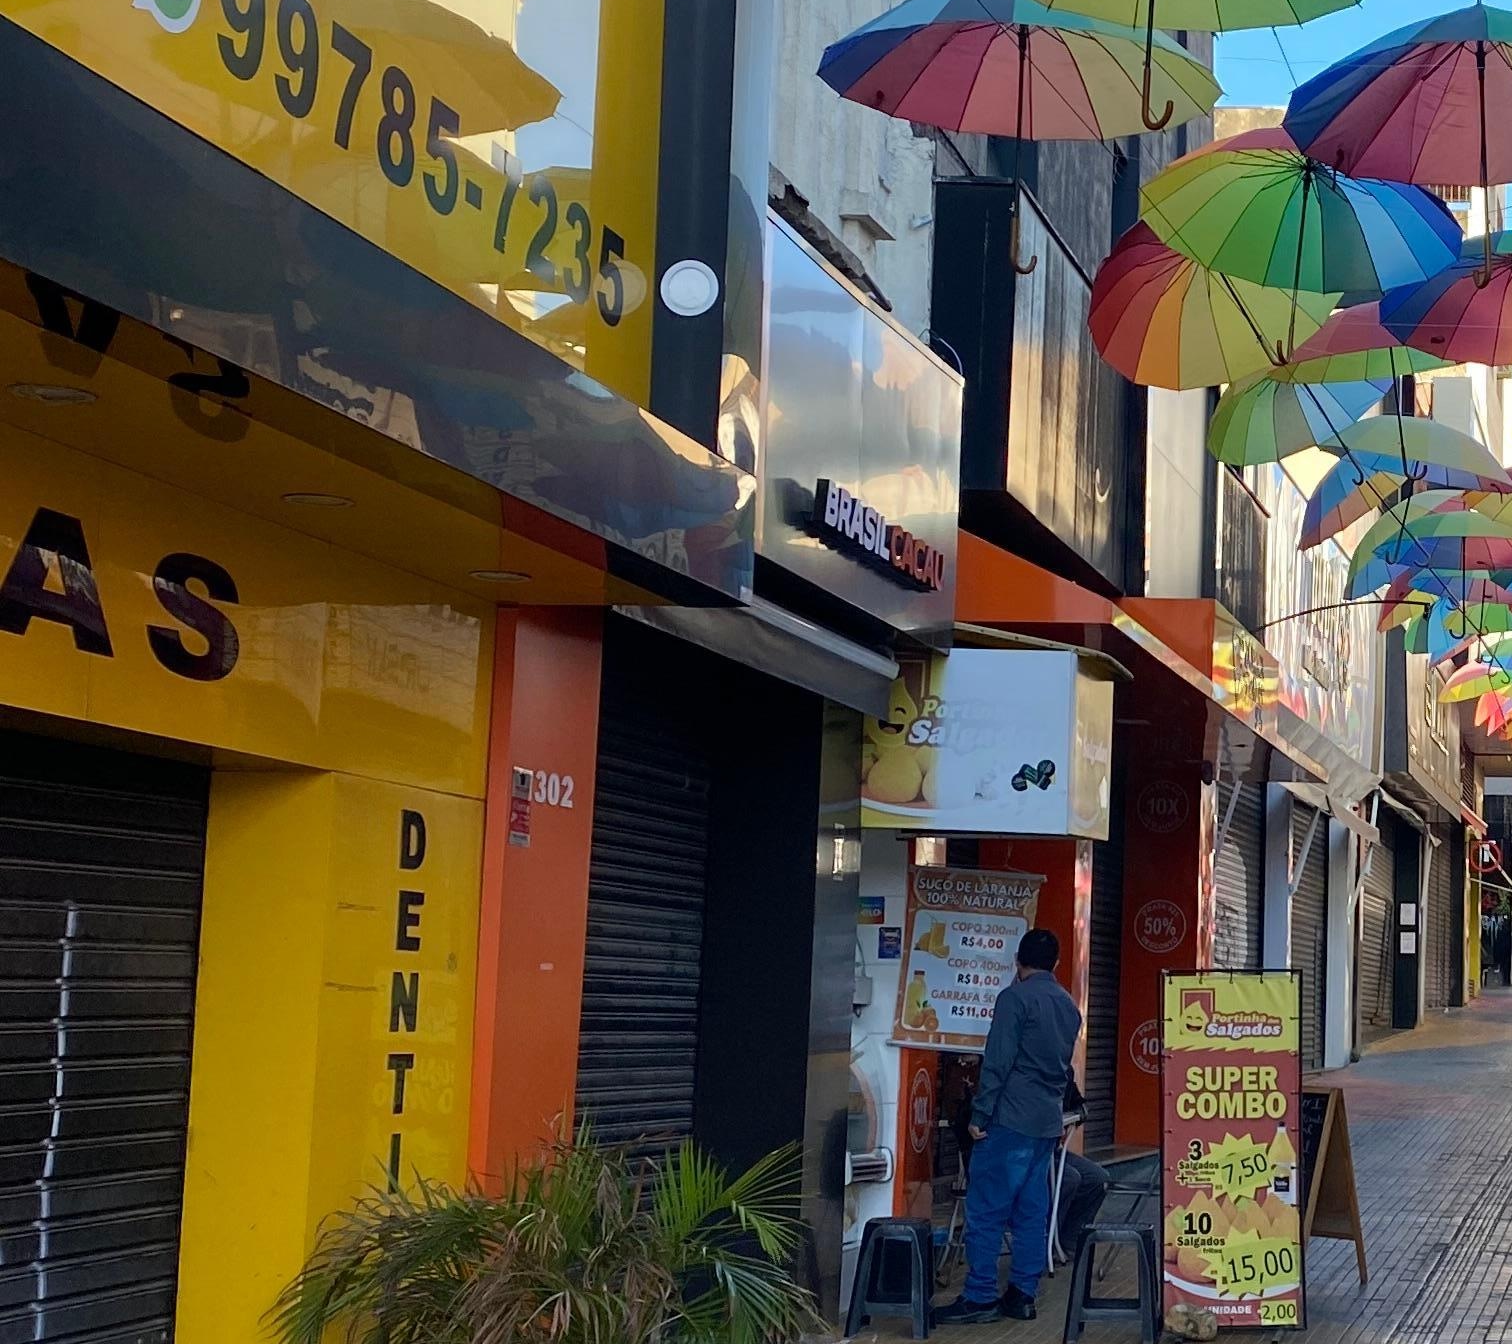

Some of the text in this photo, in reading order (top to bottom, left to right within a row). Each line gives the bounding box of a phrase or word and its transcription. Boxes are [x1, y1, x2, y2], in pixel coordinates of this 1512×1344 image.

[534, 769, 574, 808] 302
[918, 878, 1032, 898] SUCO DE LARANJA
[927, 892, 1021, 911] 100% NATURAL
[951, 921, 982, 934] COPO
[1143, 917, 1176, 936] 50%
[947, 957, 978, 970] COPO
[931, 989, 980, 1002] GARRAFA
[1211, 1012, 1267, 1023] Portinha
[1206, 1023, 1281, 1039] Salgados
[1140, 1037, 1160, 1056] 10
[1186, 1066, 1278, 1092] SUPER
[1176, 1091, 1287, 1120] COMBO
[1189, 1141, 1202, 1161] 3
[1178, 1160, 1219, 1171] Salgados
[1221, 1153, 1268, 1186] 7,50
[1184, 1212, 1212, 1235] 10
[1177, 1236, 1226, 1247] Salgados
[1228, 1248, 1294, 1285] 15,00
[1262, 1303, 1296, 1322] 2,00
